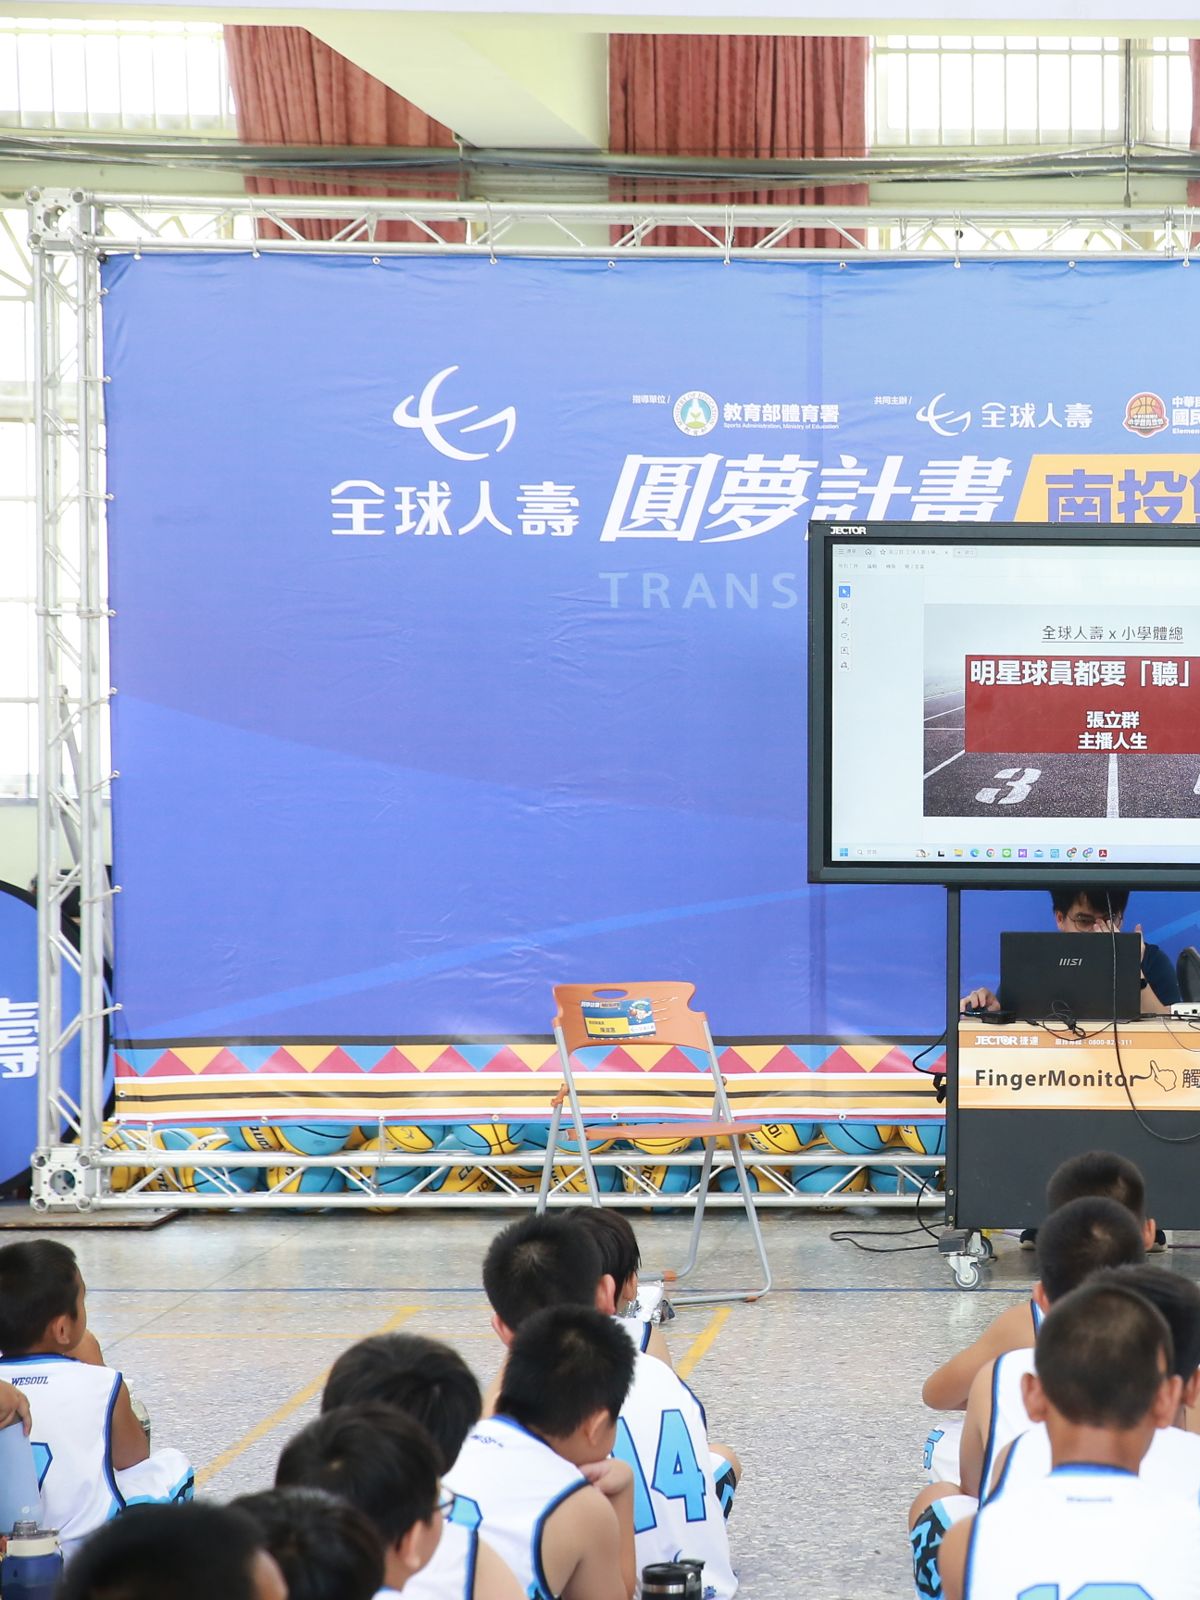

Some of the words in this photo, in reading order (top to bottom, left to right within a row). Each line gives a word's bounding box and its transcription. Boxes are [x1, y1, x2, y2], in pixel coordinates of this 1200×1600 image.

[724, 403, 840, 423] 教育部體育署
[981, 402, 1093, 429] 全球人壽
[330, 480, 580, 536] 全球人壽
[830, 526, 867, 535] JECTOR
[1042, 625, 1104, 641] 全球人壽
[1122, 626, 1183, 641] 小學體總
[1086, 711, 1140, 729] 張立群
[1078, 732, 1147, 751] 主播人生
[975, 768, 1042, 804] 3
[975, 1035, 1018, 1046] JECTOR
[975, 1069, 1138, 1090] FingerMonitor
[11, 1376, 49, 1386] WESOUL
[611, 1409, 706, 1534] 14
